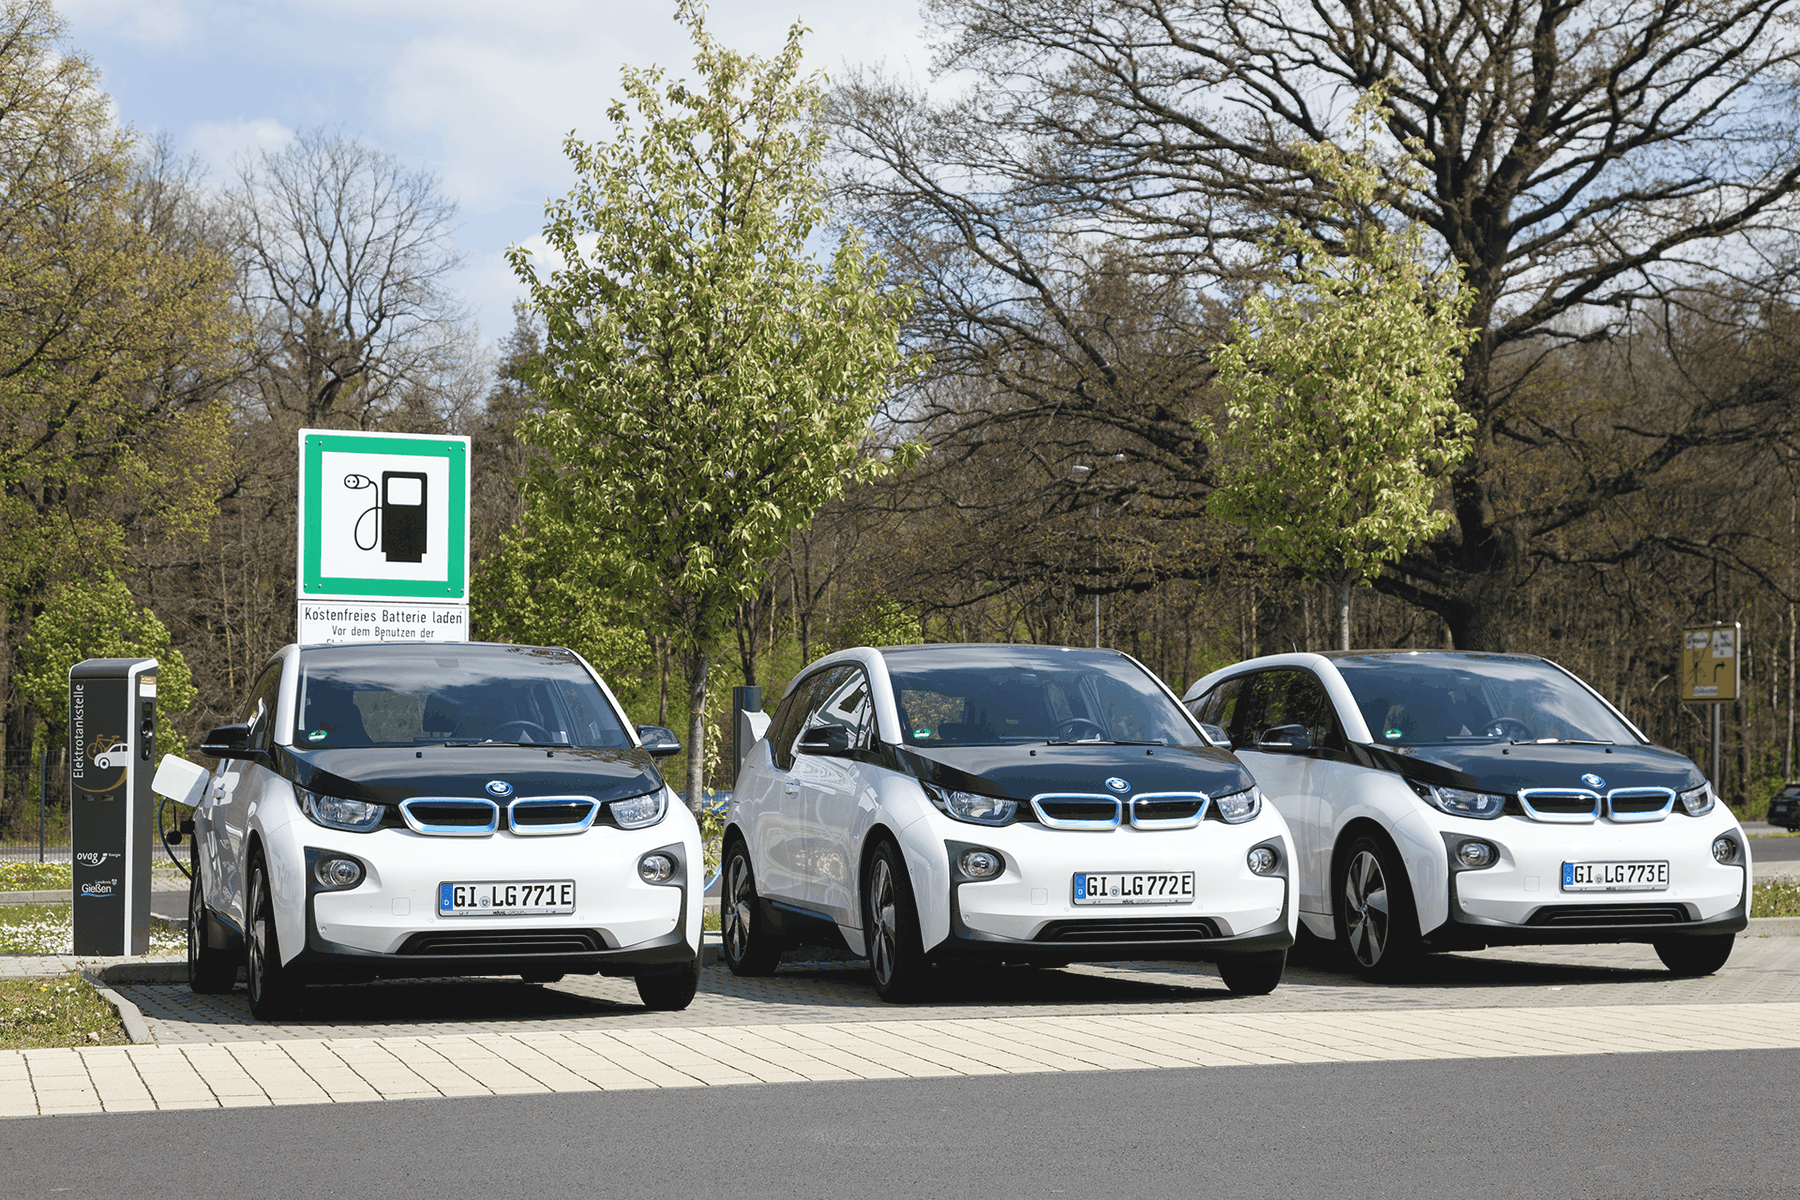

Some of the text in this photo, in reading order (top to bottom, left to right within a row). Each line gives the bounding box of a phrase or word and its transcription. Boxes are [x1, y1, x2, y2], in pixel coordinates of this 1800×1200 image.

[304, 607, 463, 624] Kostenfreies Batterie laden
[332, 625, 435, 638] Vor dem Benutzen der
[73, 684, 84, 779] Elektrotankstelle
[76, 852, 99, 864] ovag
[81, 883, 112, 893] Gießen
